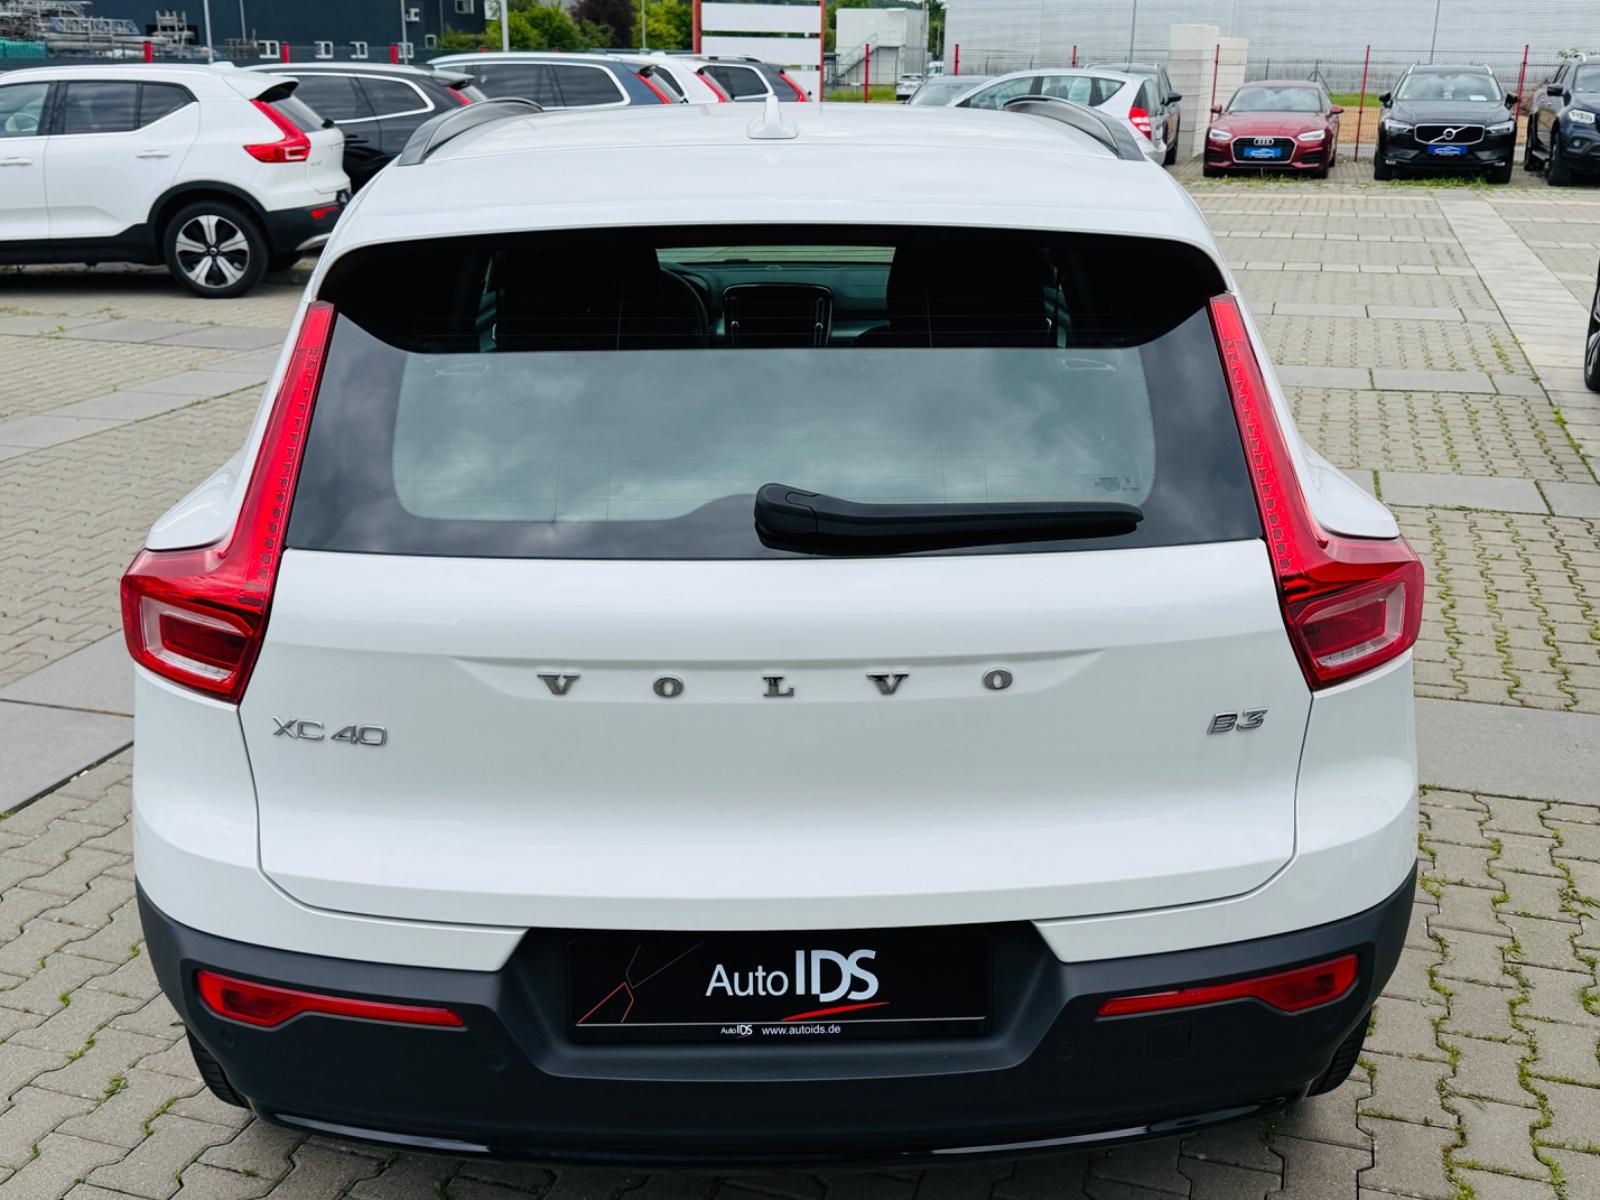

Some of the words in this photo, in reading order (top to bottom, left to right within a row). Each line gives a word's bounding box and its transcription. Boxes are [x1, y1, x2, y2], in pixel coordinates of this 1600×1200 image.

[536, 668, 1015, 698] VOLVO
[1207, 707, 1268, 735] B3
[761, 1024, 841, 1035] www.autoids.de
